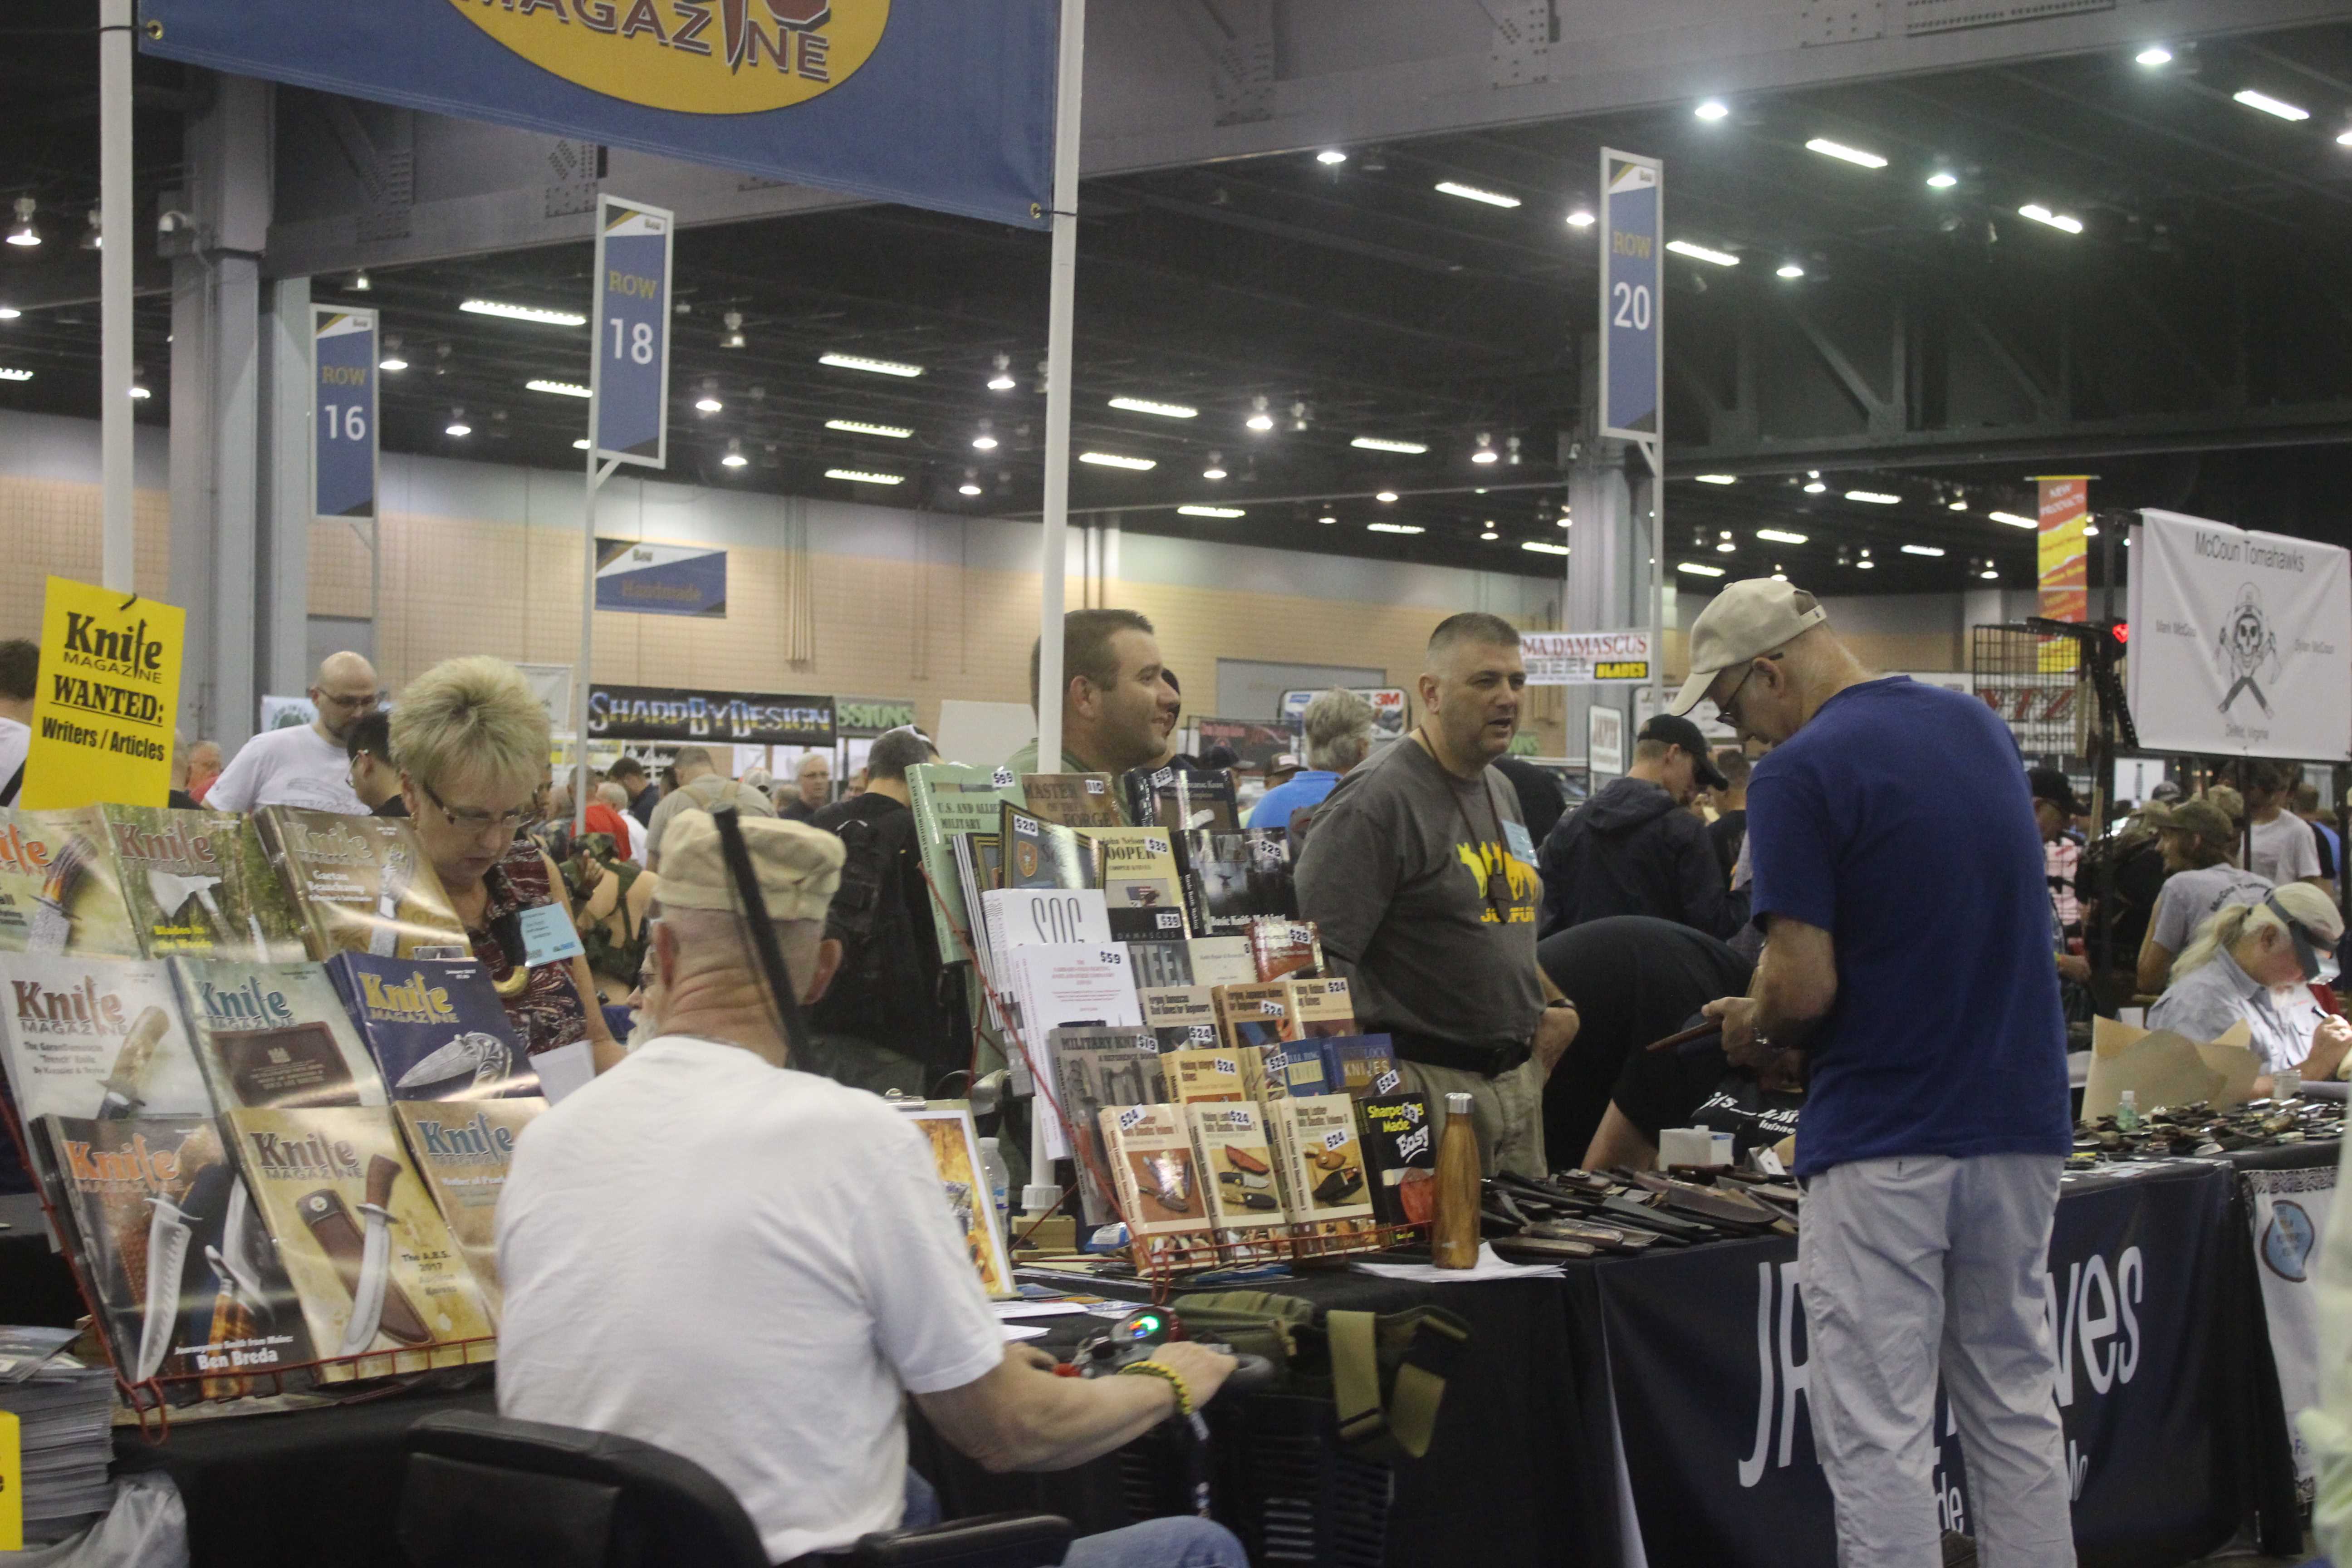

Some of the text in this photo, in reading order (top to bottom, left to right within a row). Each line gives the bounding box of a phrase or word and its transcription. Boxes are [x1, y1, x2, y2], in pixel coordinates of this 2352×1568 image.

[463, 0, 829, 80] GAZINE
[1612, 231, 1651, 259] ROW
[609, 270, 657, 299] ROW
[1614, 282, 1650, 330] 20
[610, 318, 652, 364] 18
[322, 367, 366, 385] ROW
[325, 405, 365, 440] 16
[2050, 484, 2073, 498] NEW
[2244, 540, 2304, 572] Tomahawks
[65, 611, 162, 676] Knife
[1553, 635, 1646, 655] DAMASCUS
[64, 651, 162, 684] MAGAZINE
[1596, 663, 1647, 678] BLADES
[53, 674, 164, 723] WANTED:
[1374, 692, 1400, 706] 3M
[42, 716, 98, 749] Writers
[110, 731, 165, 762] Articles
[1016, 817, 1036, 833] $20
[112, 818, 216, 866] Knife
[1106, 846, 1156, 860] OOPER
[1290, 929, 1308, 941] $29
[1100, 951, 1121, 964] $59
[358, 971, 453, 1016] Knife
[1328, 981, 1346, 992] $24
[11, 975, 124, 1026] Knife
[198, 975, 291, 1020] Knife
[1264, 1003, 1283, 1016] $24
[1138, 1035, 1156, 1051] $19
[1190, 1027, 1210, 1039] $24
[1217, 1059, 1235, 1073] $24
[1270, 1055, 1287, 1070] $29
[1378, 1074, 1398, 1089] $24
[1121, 1109, 1139, 1126] $24
[1230, 1110, 1249, 1123] $24
[1382, 1120, 1411, 1132] Made
[416, 1112, 515, 1156] Knife
[1327, 1131, 1344, 1148] $24
[1396, 1125, 1429, 1158] Easy
[62, 1132, 179, 1182] Knife
[250, 1131, 359, 1170] Knife
[196, 1347, 279, 1370] Ben Breda
